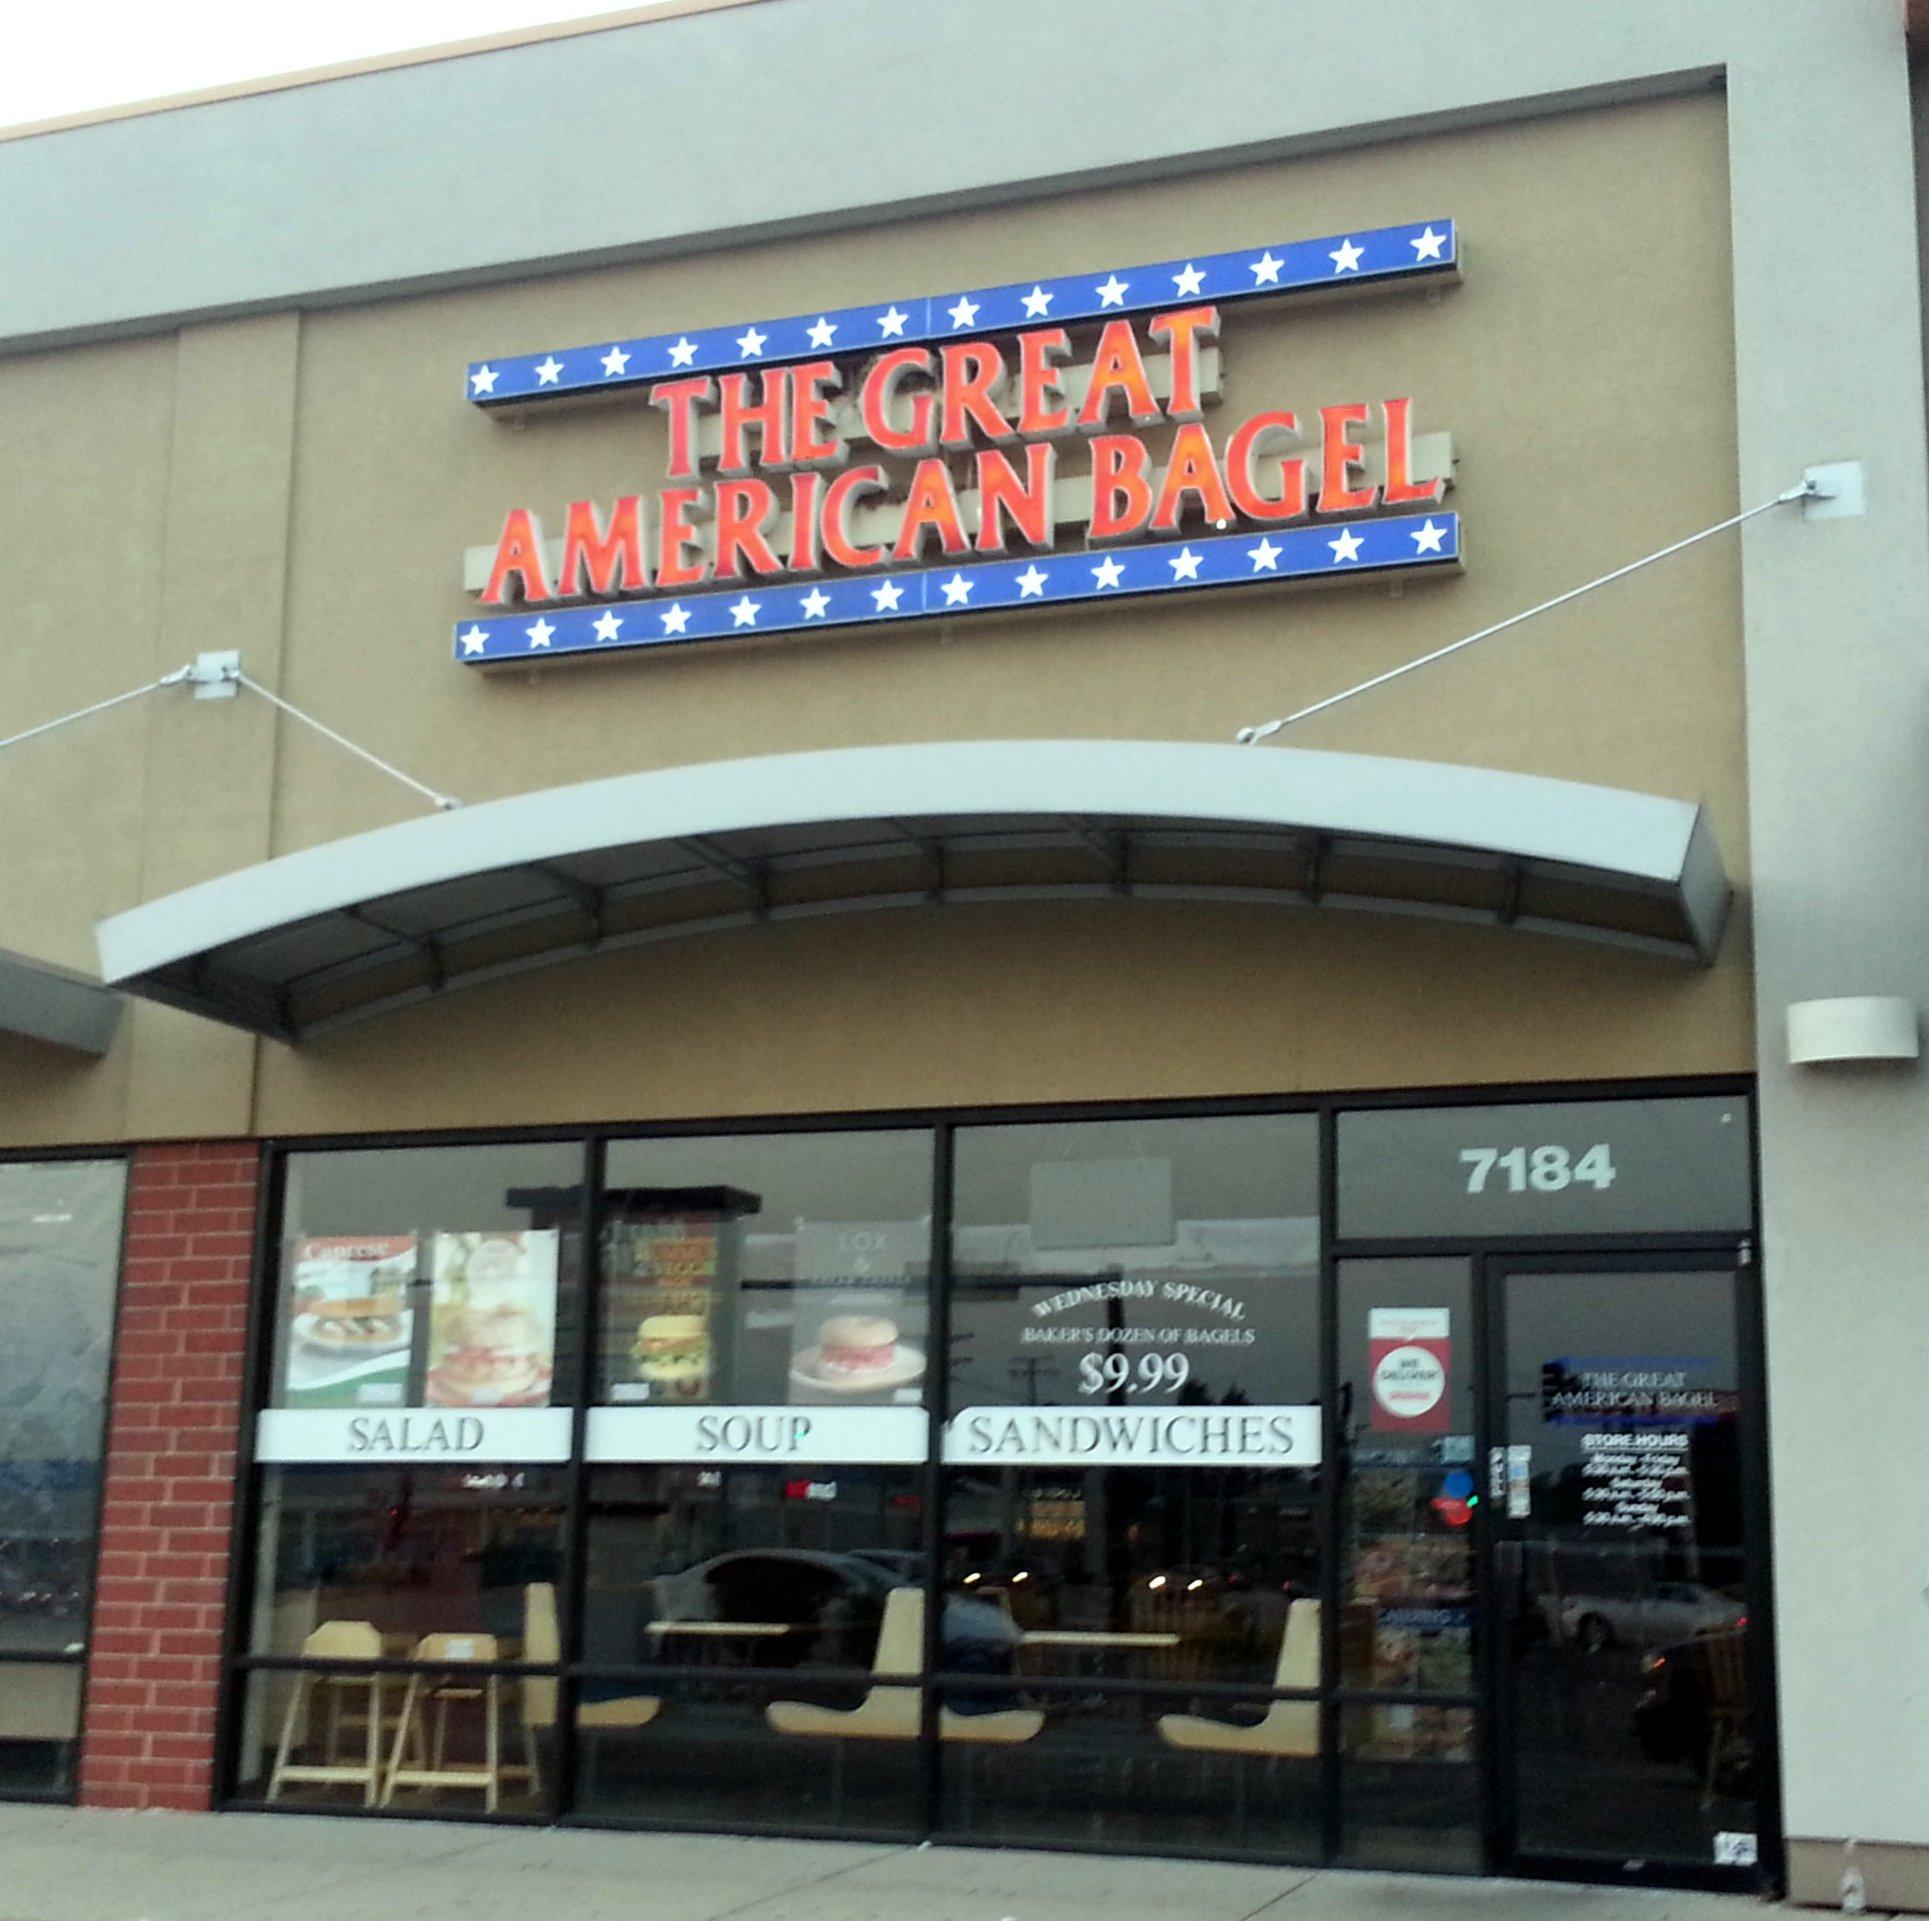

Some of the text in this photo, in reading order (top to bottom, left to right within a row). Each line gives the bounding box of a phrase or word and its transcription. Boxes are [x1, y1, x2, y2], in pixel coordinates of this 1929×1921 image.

[650, 306, 1218, 479] THE GREAT
[480, 397, 1440, 604] AMERICAN BAGEL
[1460, 1144, 1616, 1193] 7184
[1031, 1280, 1246, 1321] WEDNESDAY SPECIAL
[1021, 1327, 1256, 1344] BAKER'S DOZEN OF BAGELS
[1078, 1351, 1190, 1395] $9.99
[1581, 1371, 1688, 1388] THE GREAT
[1551, 1389, 1720, 1407] AMERICAN BAGEL
[348, 1417, 484, 1452] SALAD
[697, 1414, 811, 1453] SOUP
[970, 1414, 1294, 1455] SANDWICHES
[1581, 1433, 1690, 1449] STORE HOURS
